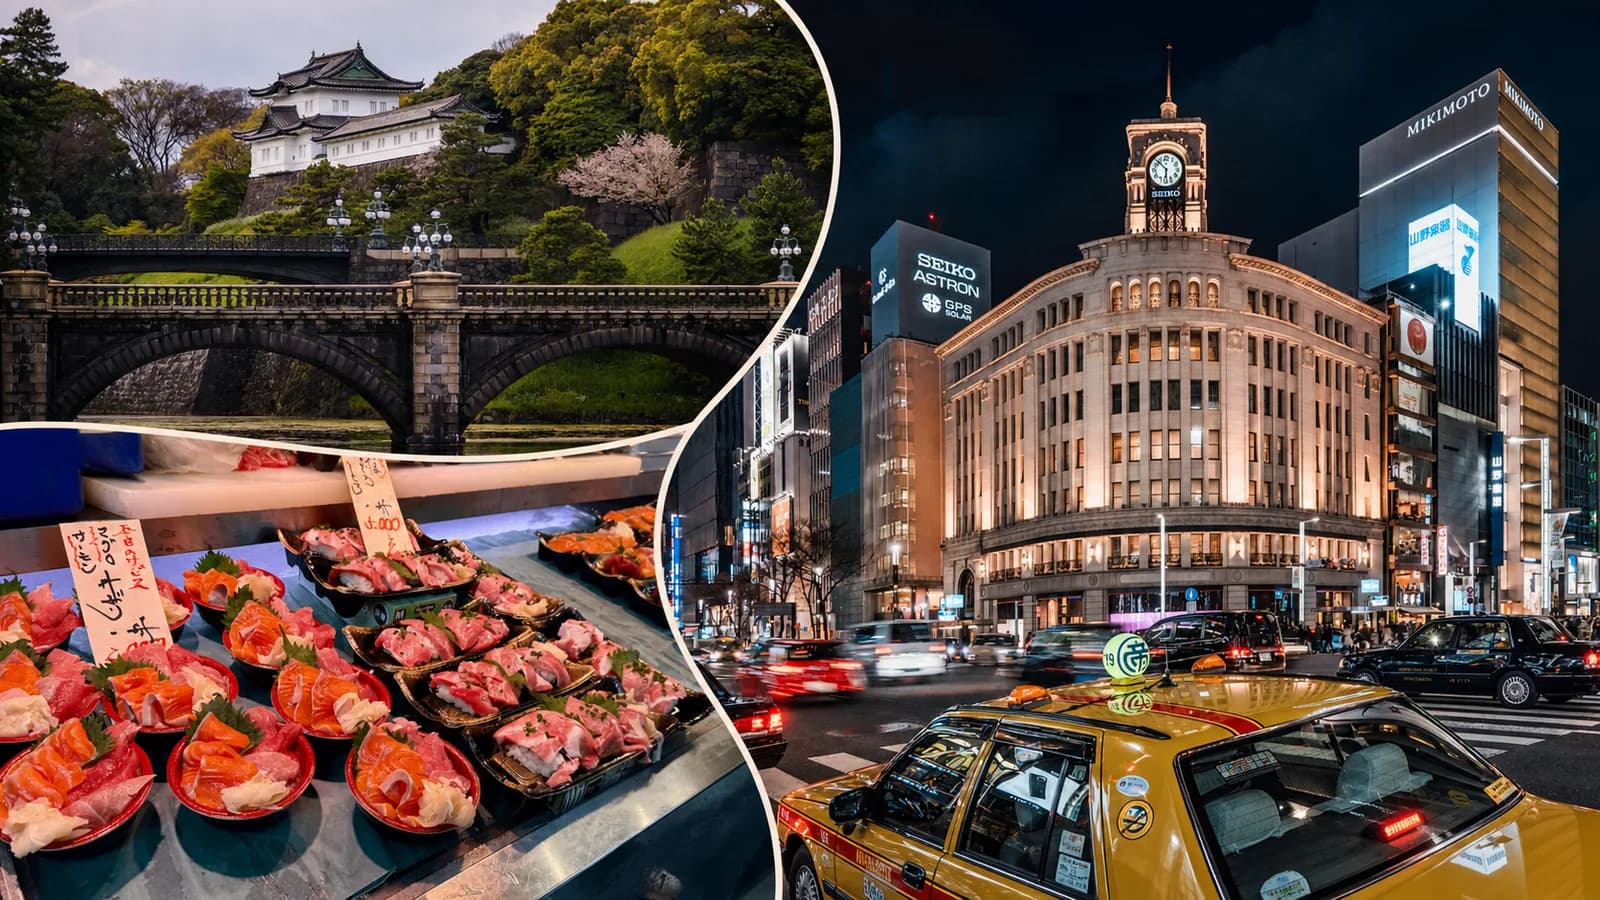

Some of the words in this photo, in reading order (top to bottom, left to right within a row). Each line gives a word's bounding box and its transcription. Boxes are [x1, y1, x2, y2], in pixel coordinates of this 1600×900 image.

[1407, 83, 1490, 138] MIKIMOTO
[1504, 80, 1544, 131] MIKIMOTO
[918, 252, 976, 281] SEIKO
[913, 269, 980, 299] ASTRON
[945, 299, 973, 315] GPS
[945, 309, 972, 322] SOLAR
